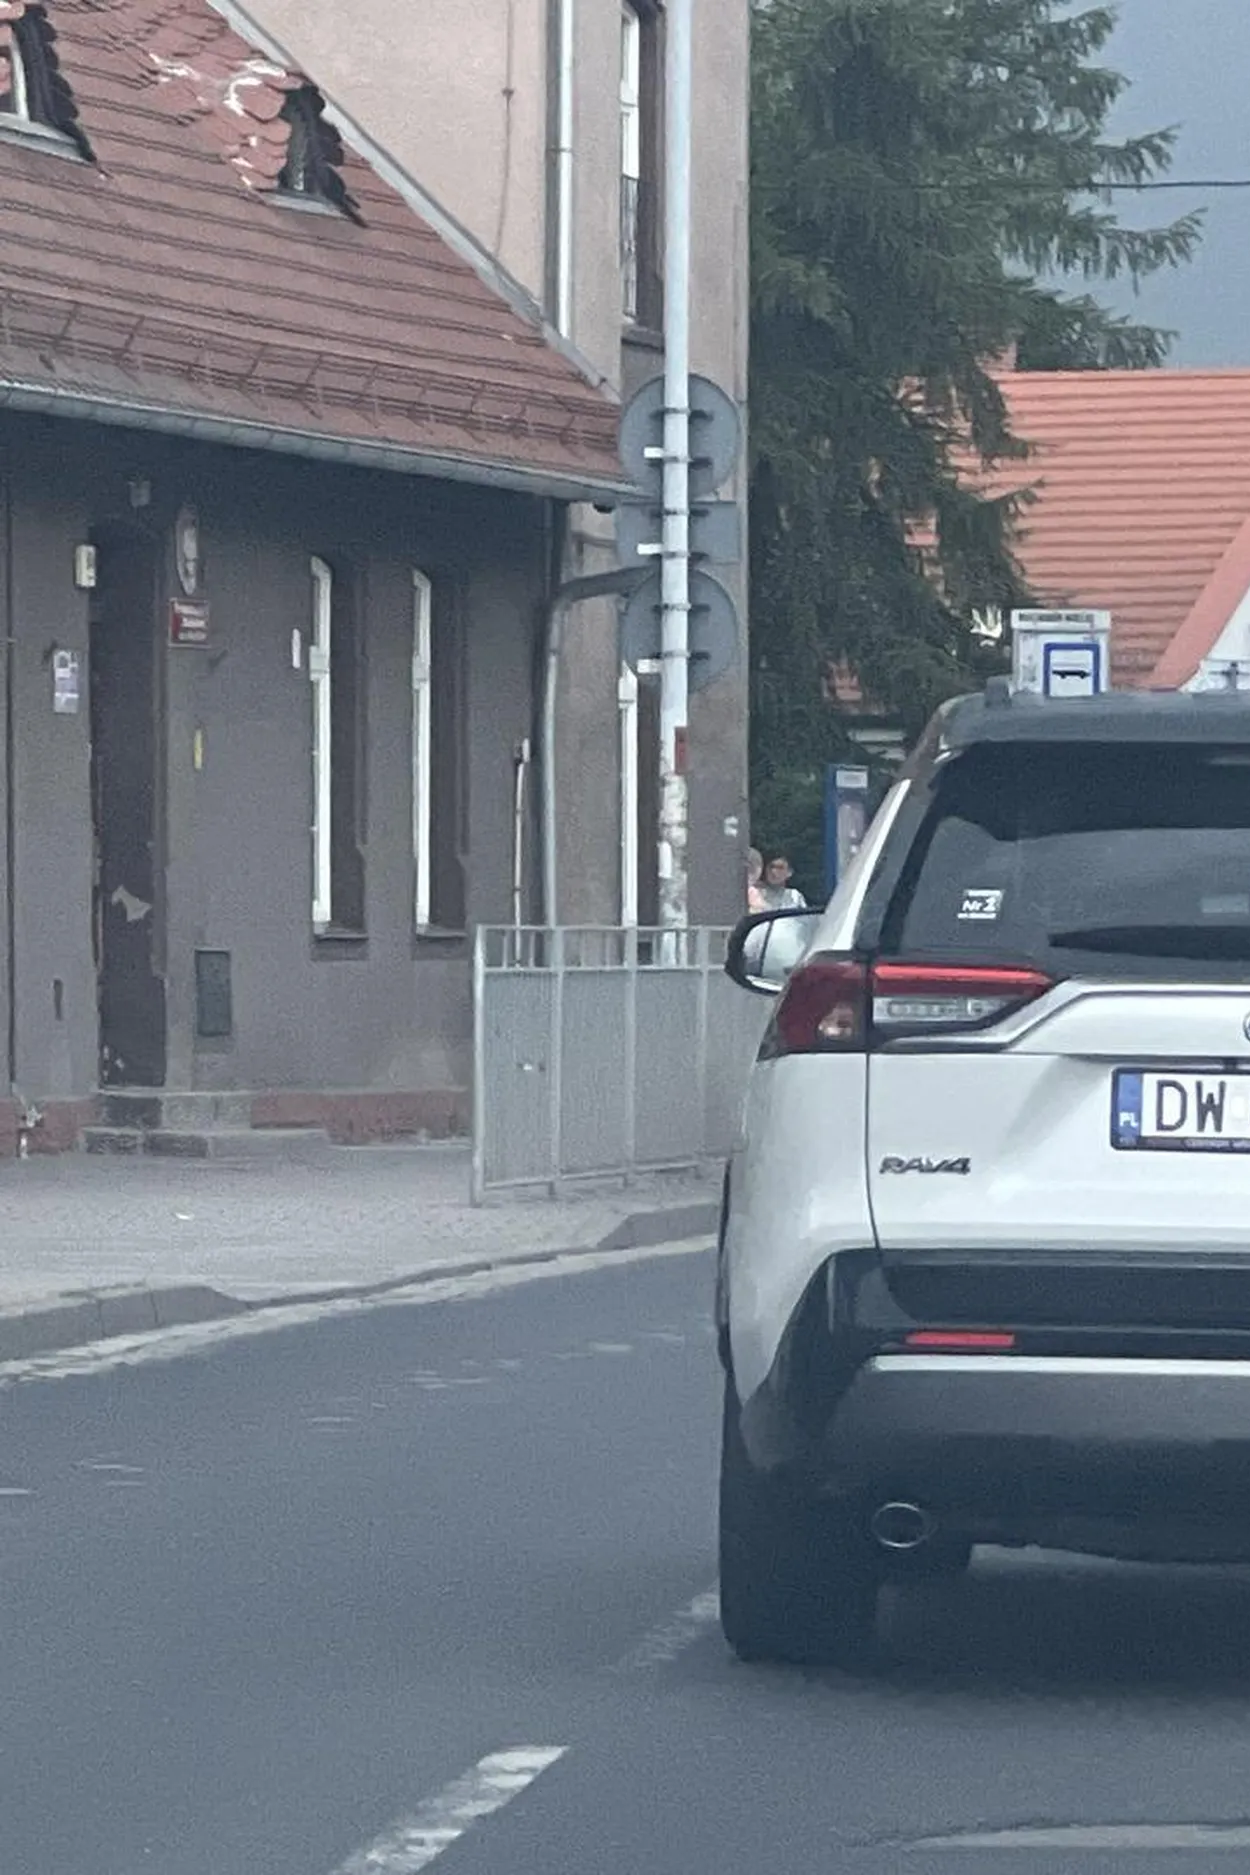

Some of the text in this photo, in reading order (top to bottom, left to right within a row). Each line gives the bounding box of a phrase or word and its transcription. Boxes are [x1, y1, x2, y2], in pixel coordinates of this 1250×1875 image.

[1156, 1080, 1226, 1133] DW
[1119, 1112, 1138, 1128] PL
[879, 1157, 971, 1175] RAV4
